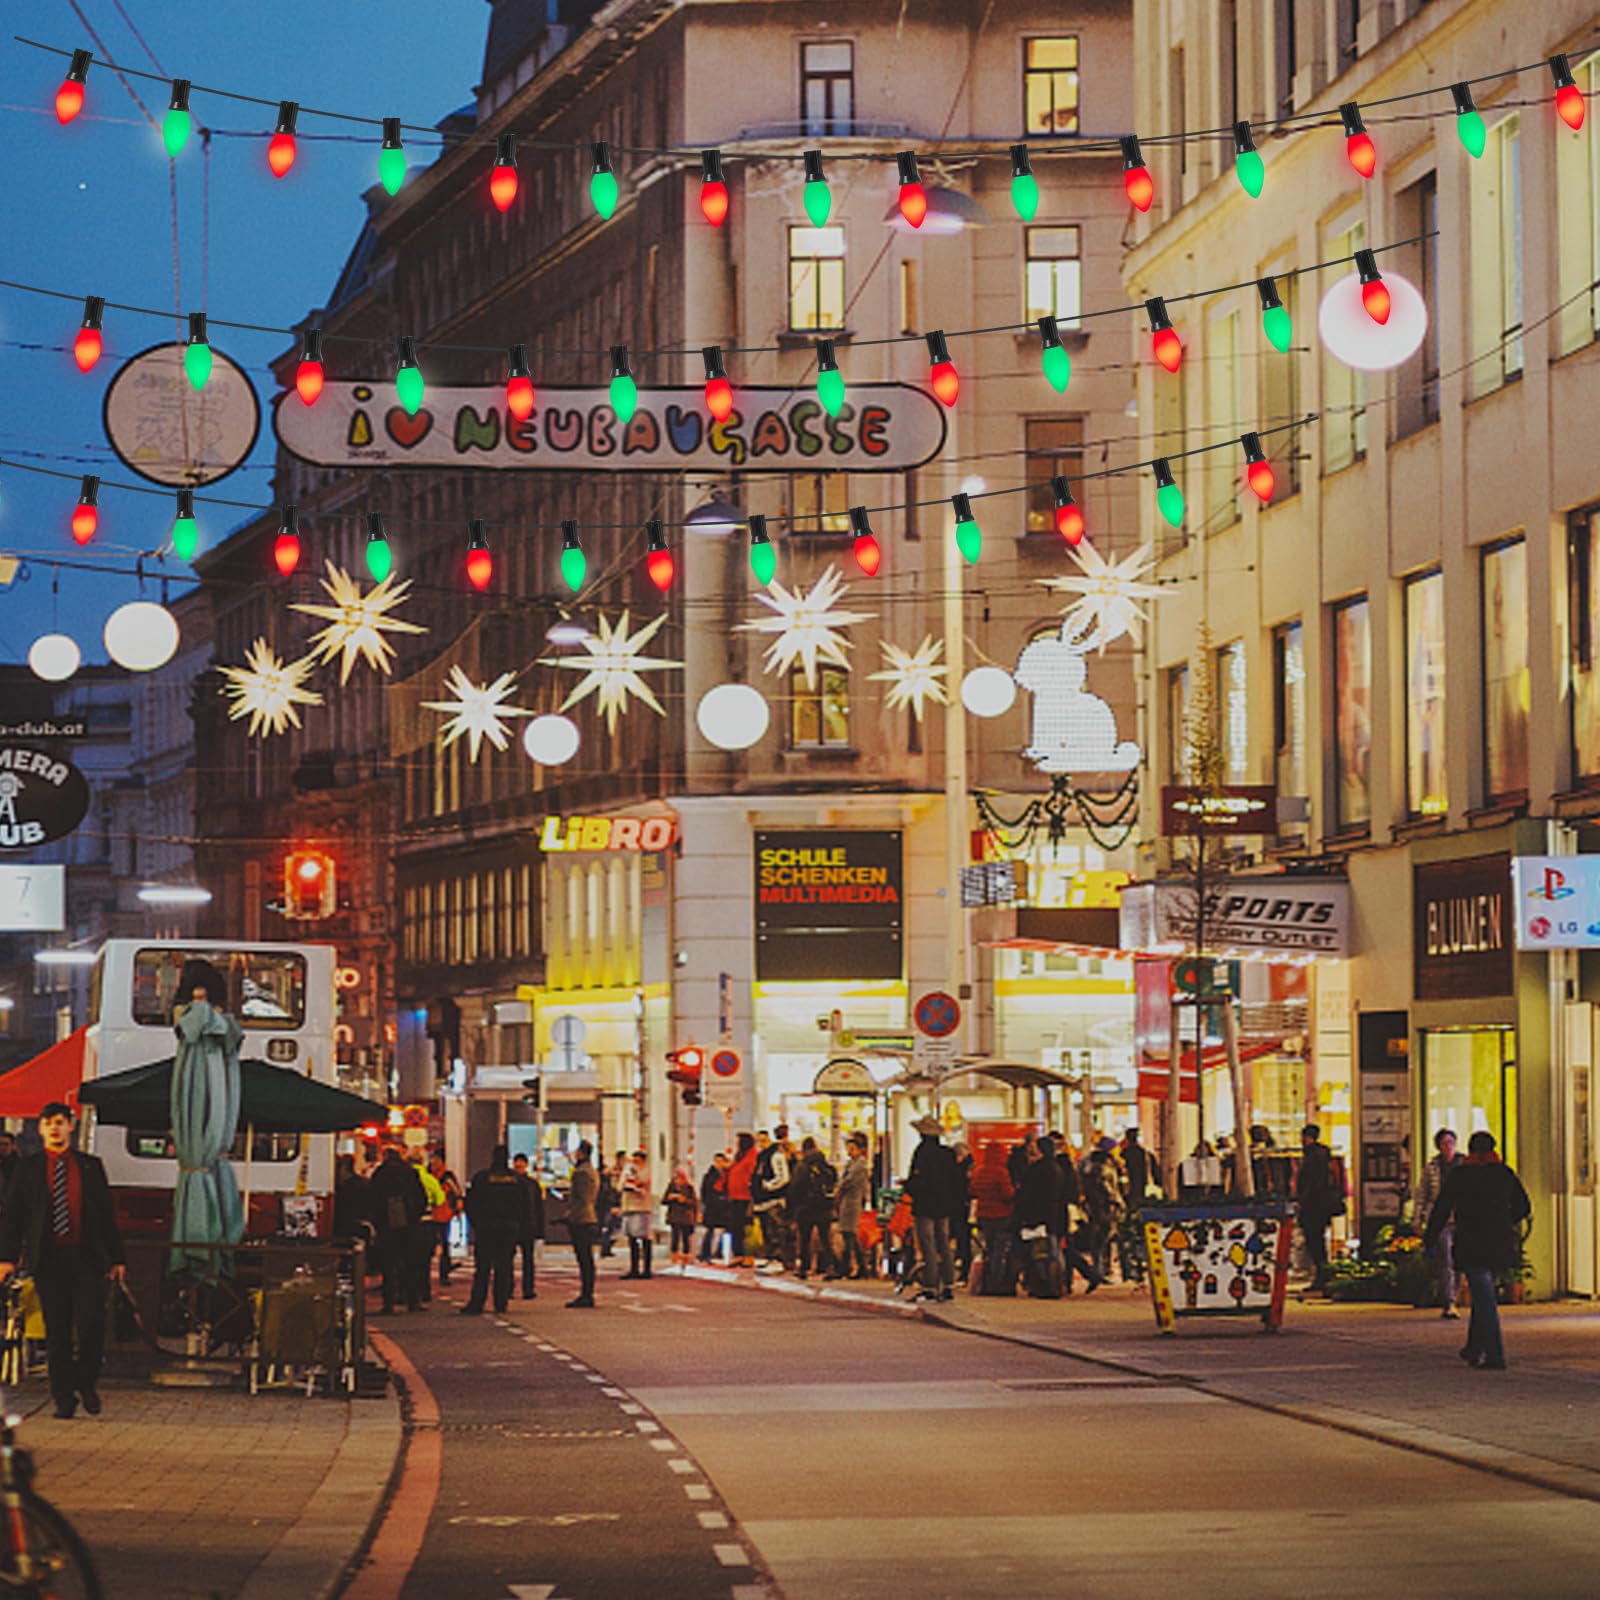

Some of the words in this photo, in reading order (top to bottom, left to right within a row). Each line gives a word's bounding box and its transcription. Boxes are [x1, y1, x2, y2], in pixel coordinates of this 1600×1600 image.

[454, 399, 891, 465] NEUBAUGASSE
[760, 848, 847, 866] SCHULE
[760, 867, 887, 885] SCHENKEN
[760, 885, 898, 903] MULTIMEDIA
[1427, 893, 1503, 956] BLUMEN
[1558, 921, 1579, 935] LG
